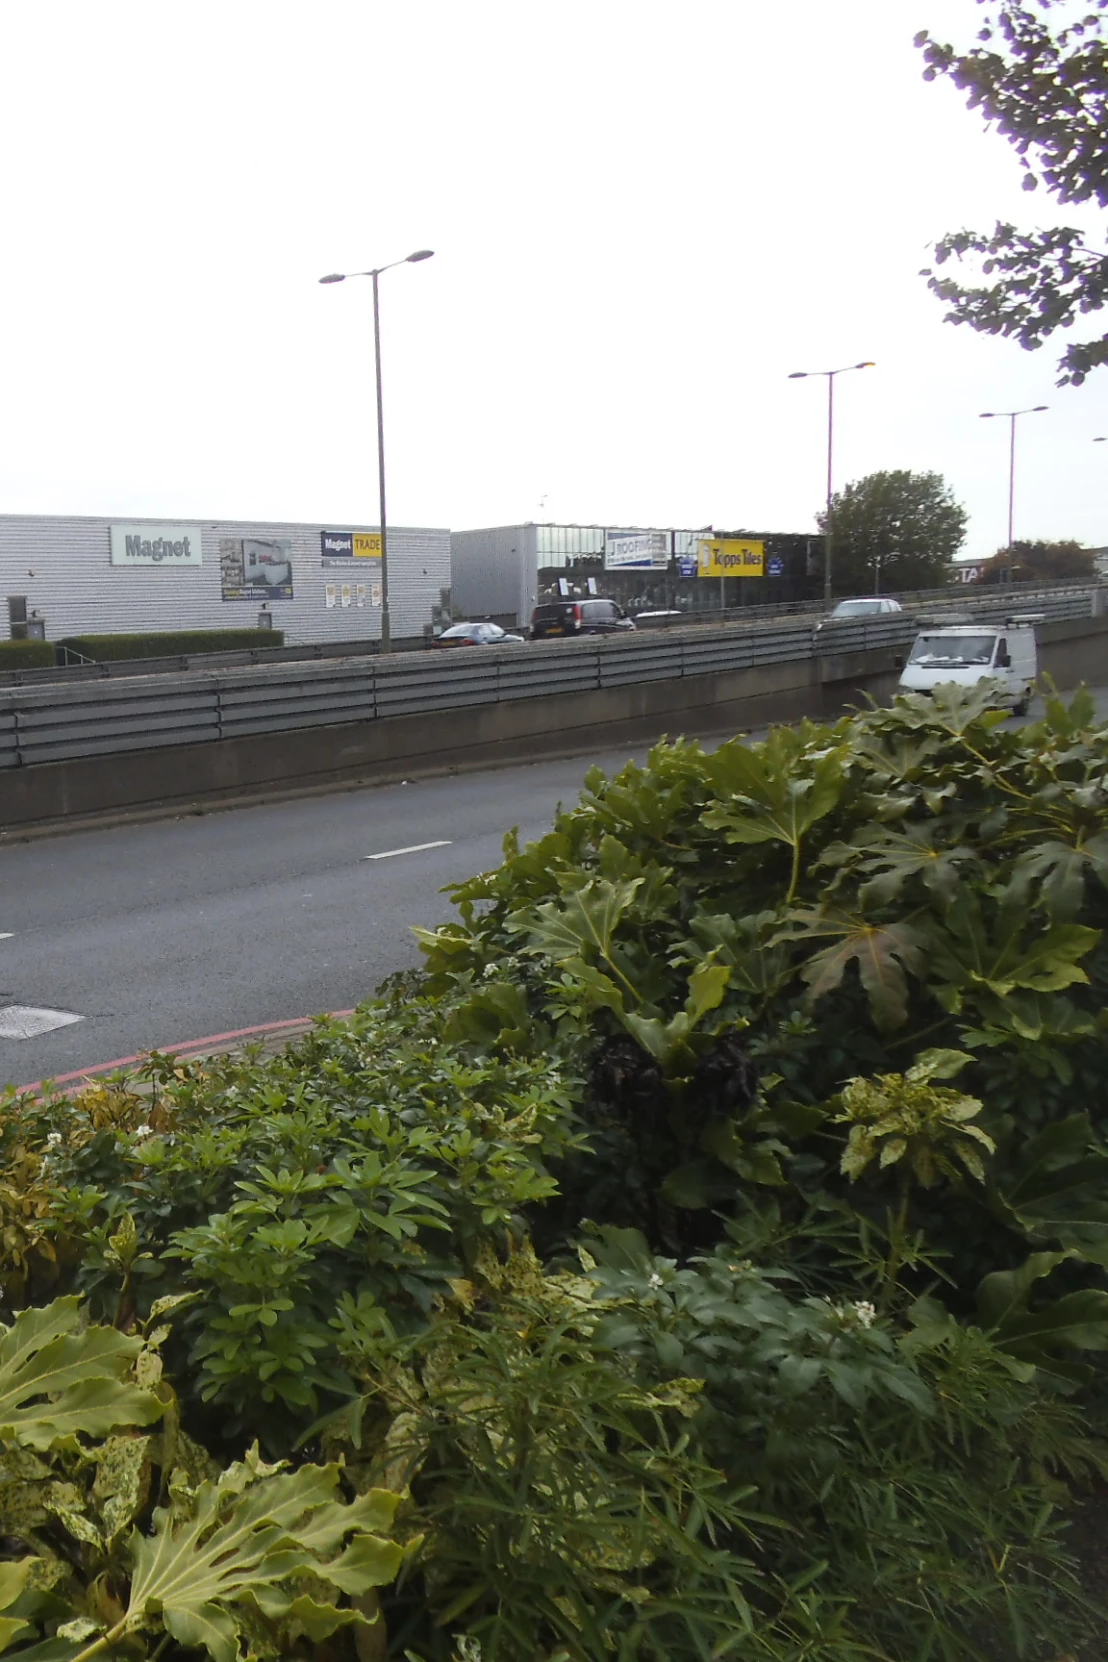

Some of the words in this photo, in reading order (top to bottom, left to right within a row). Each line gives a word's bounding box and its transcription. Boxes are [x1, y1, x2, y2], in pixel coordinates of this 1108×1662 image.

[125, 534, 191, 562] Magnet
[325, 538, 351, 552] Magnet
[355, 539, 381, 550] TRADE
[712, 548, 741, 569] Topps
[742, 548, 762, 566] Tiles
